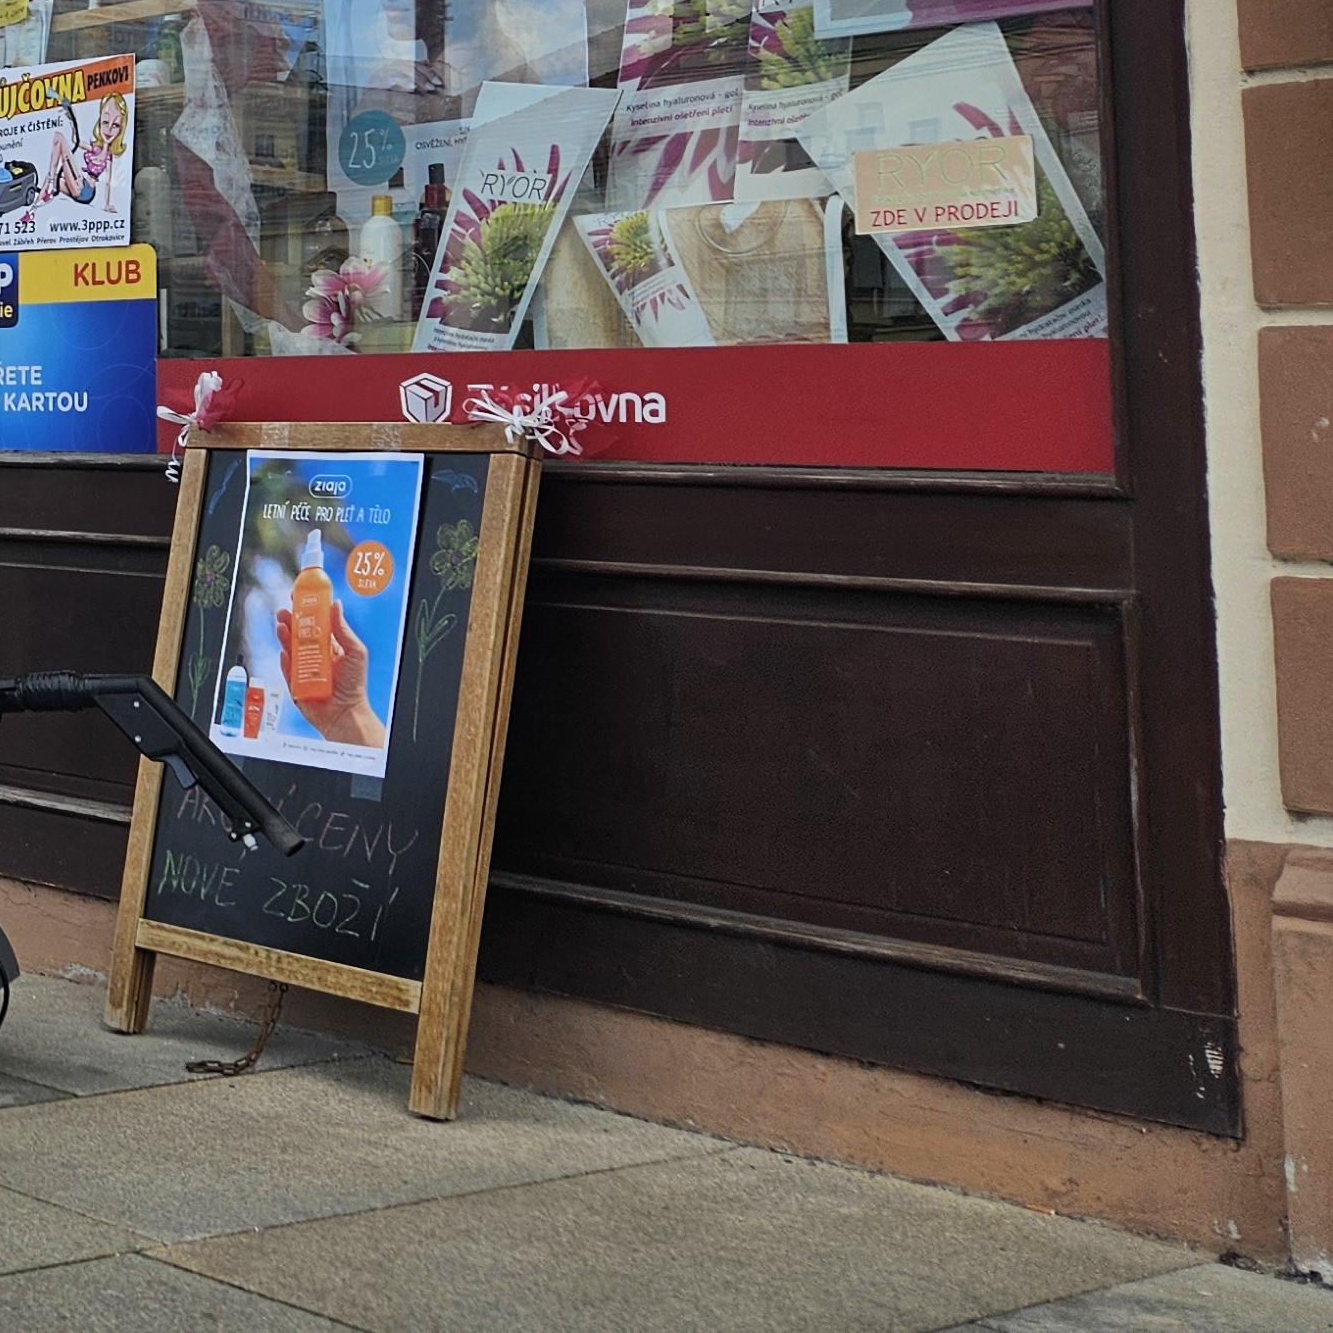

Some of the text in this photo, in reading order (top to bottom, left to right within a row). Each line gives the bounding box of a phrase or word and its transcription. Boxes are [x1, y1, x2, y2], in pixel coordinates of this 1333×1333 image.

[87, 65, 129, 91] PENKOVI
[20, 126, 26, 134] K
[876, 144, 1009, 190] RYOR
[480, 173, 548, 200] RYOR
[870, 200, 1019, 228] ZDE V PRODEJI
[14, 220, 36, 235] 523
[50, 218, 125, 237] www.3ppp.cz
[73, 259, 142, 287] KLUB
[3, 391, 88, 412] KARTOU
[313, 478, 347, 494] ziaja
[263, 500, 289, 520] LETNÍ
[315, 506, 334, 522] PRO
[356, 507, 364, 522] A
[366, 505, 391, 524] TĚLO
[353, 551, 385, 577] 25%
[294, 802, 419, 876] CENY
[157, 848, 247, 906] NOVÉ
